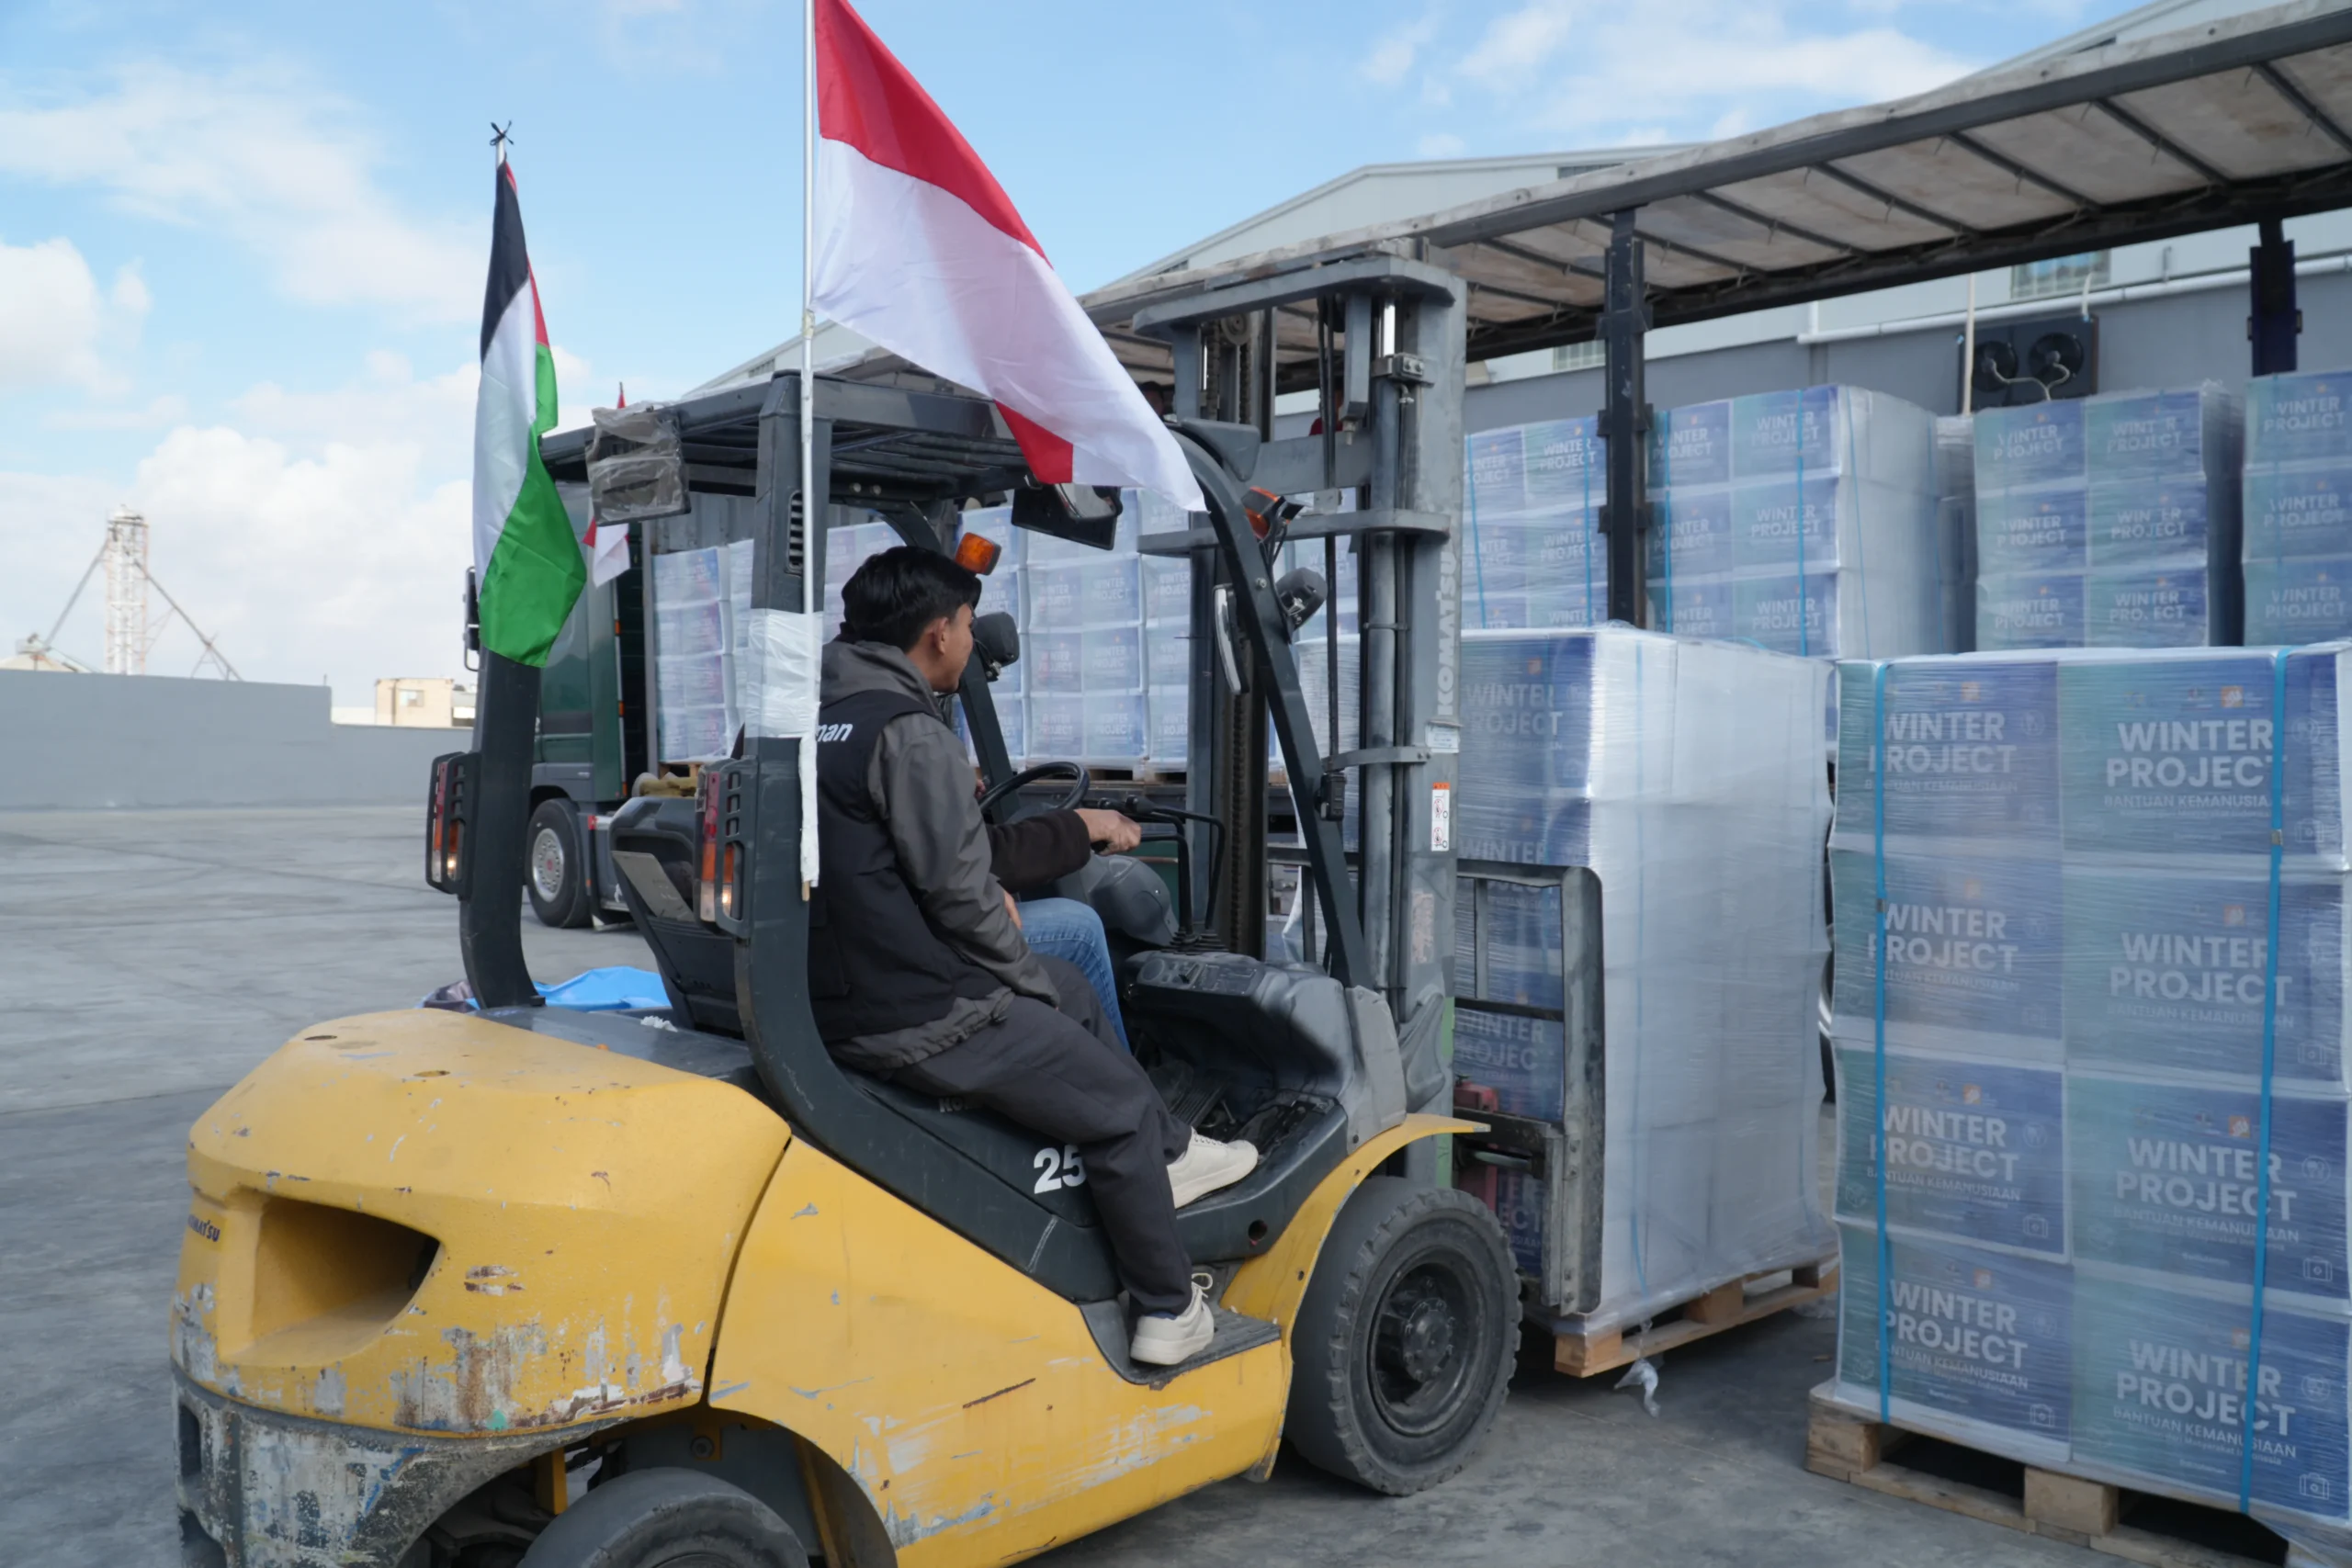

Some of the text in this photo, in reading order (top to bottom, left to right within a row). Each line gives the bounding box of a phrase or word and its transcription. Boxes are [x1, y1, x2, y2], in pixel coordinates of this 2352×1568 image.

[1757, 412, 1815, 431] WINTR
[2113, 416, 2177, 436] WINTR
[2264, 412, 2346, 433] PROJECT
[1657, 427, 1709, 446] WNTER
[1757, 505, 1816, 522] WINTR
[2118, 507, 2182, 525] WINER
[1655, 534, 1714, 551] POJECT
[1757, 597, 1816, 615] WINTR
[1435, 550, 1457, 716] KOMATSU
[1883, 711, 2006, 741] WINTER
[2117, 718, 2275, 752] WINTER
[2106, 755, 2290, 788] PROJEC
[2177, 795, 2290, 808] KEMANUSIAN
[1883, 902, 2007, 941] WINTER
[2109, 965, 2293, 1007] PROJECT
[2180, 1009, 2296, 1029] KEMANUSIAN
[1882, 1103, 2007, 1147] WINTER
[1033, 1144, 1087, 1195] 25
[2127, 1136, 2283, 1184] WINTER
[1867, 1167, 1925, 1187] BNTUAN
[1927, 1175, 2021, 1201] KEMANUSIAAN
[2116, 1169, 2299, 1223] PROJECT
[2186, 1216, 2300, 1244] KEMANUAAN
[1890, 1278, 2018, 1336] WINTER
[1875, 1339, 1931, 1366] NTUAN
[2128, 1338, 2282, 1398] WINTER
[2116, 1371, 2297, 1437] PROJECT
[2113, 1405, 2182, 1433] BANTUAN
[2236, 1448, 2282, 1466] Inonesia
